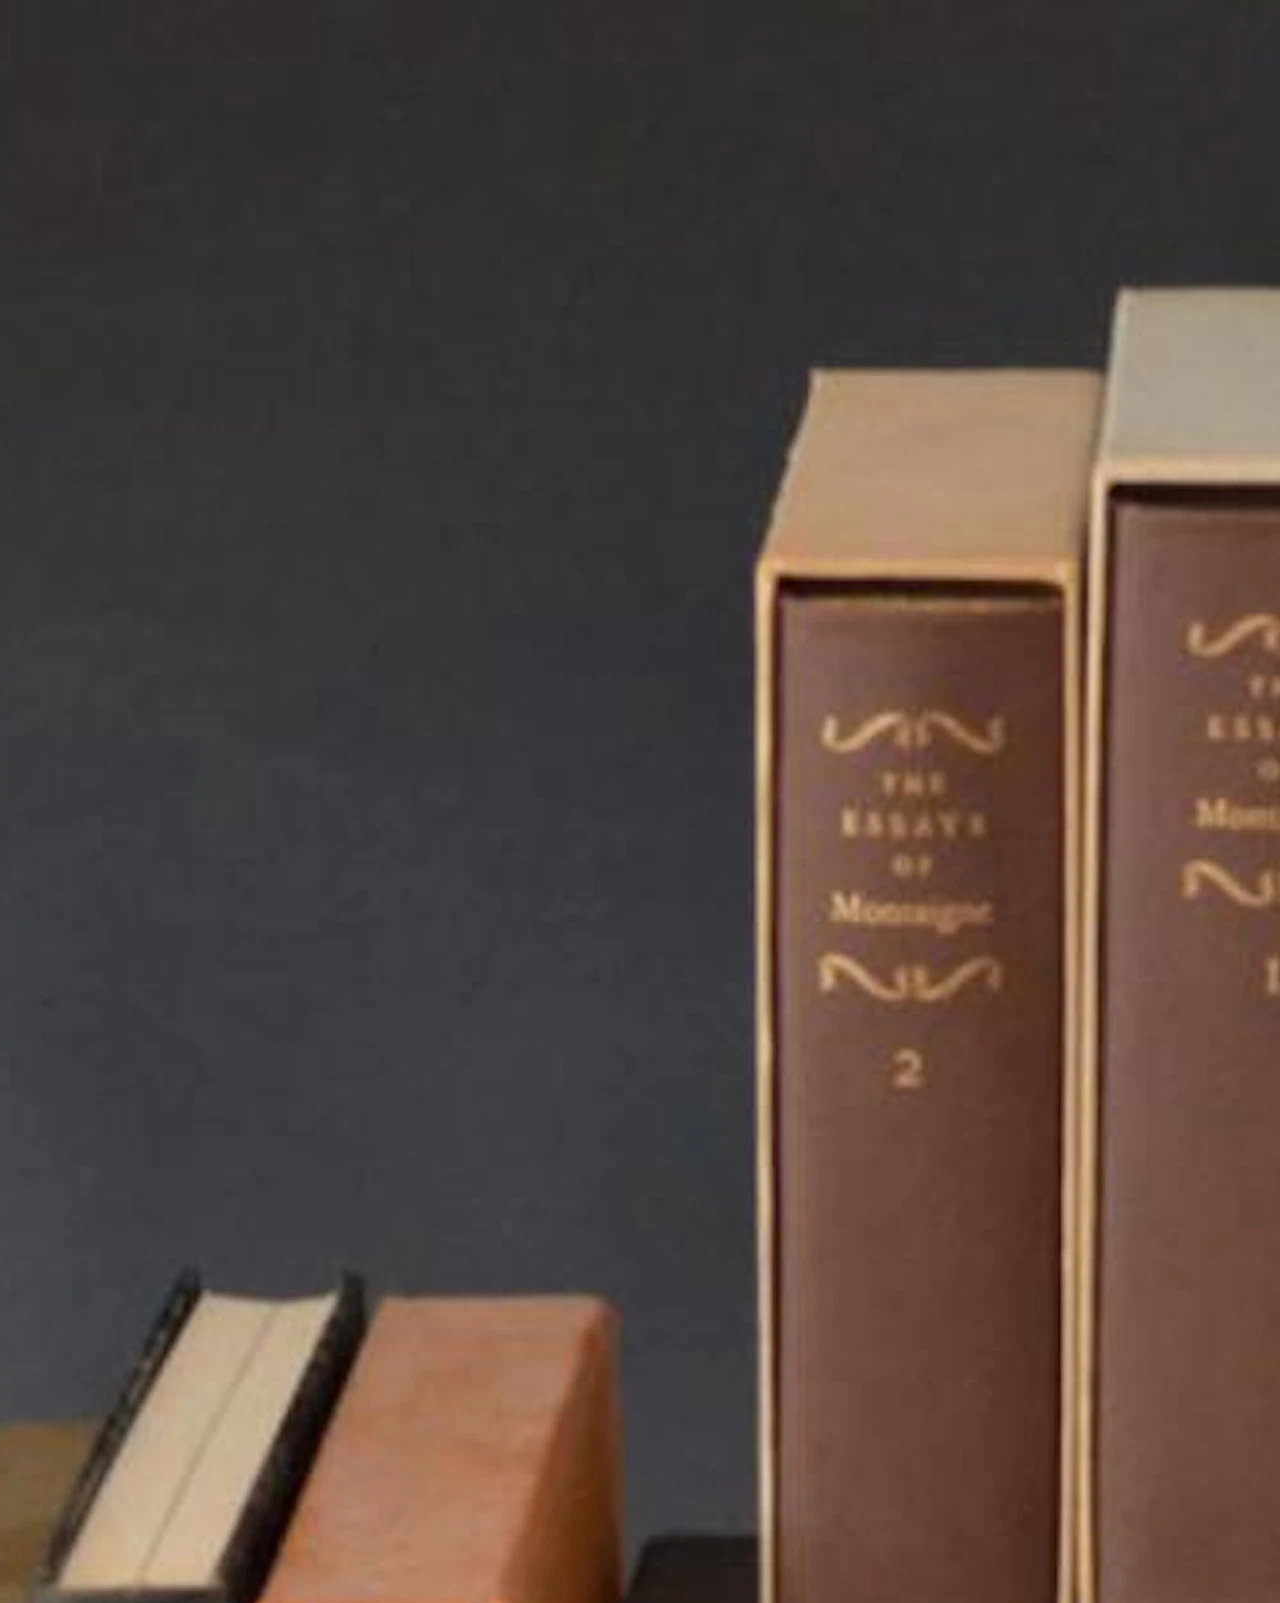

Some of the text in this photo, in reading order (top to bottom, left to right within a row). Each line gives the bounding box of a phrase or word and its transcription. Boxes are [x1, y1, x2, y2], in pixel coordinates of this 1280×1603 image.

[882, 773, 946, 794] THE
[842, 810, 988, 837] ESSAYS
[894, 855, 934, 877] OF
[830, 891, 992, 932] Montaigne
[894, 1050, 921, 1086] 2
